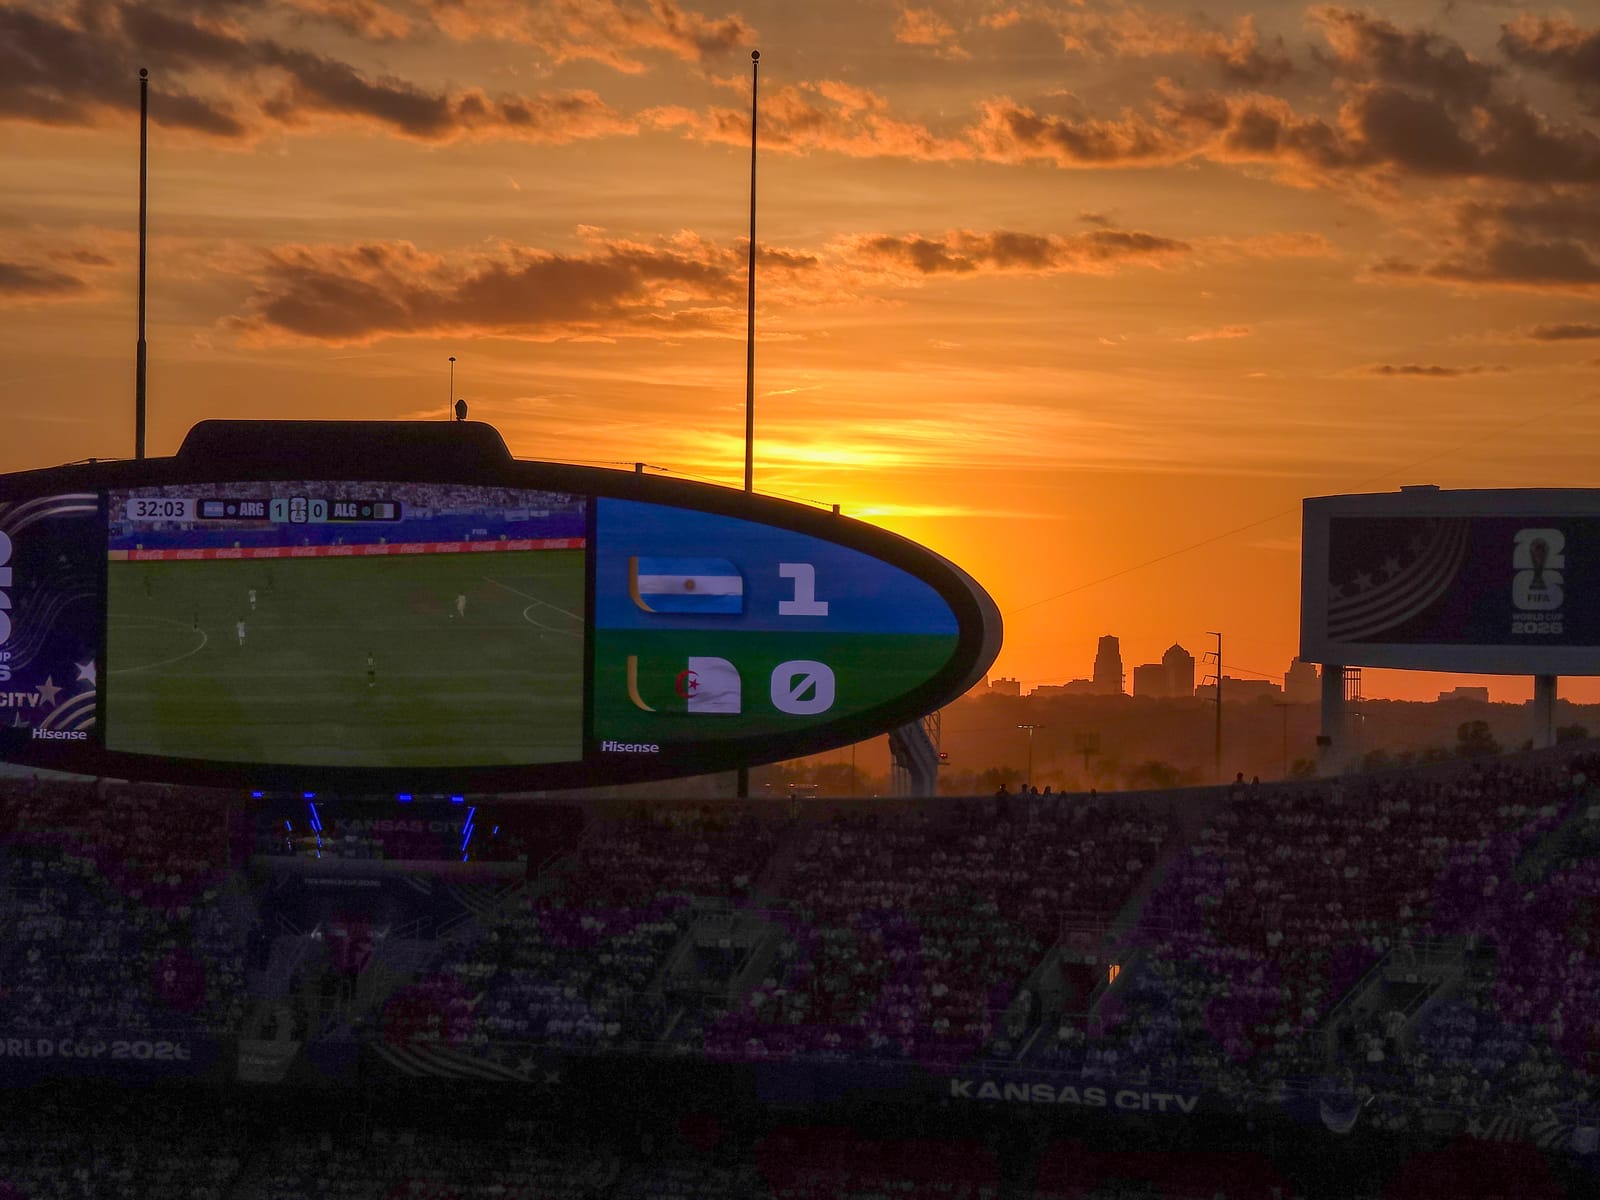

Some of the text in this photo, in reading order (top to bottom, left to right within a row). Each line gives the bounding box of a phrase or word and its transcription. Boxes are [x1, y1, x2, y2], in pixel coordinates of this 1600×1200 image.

[136, 501, 184, 517] 32:03
[239, 502, 265, 517] ARG
[274, 503, 283, 518] 1
[313, 503, 323, 518] 0
[333, 503, 358, 518] ALG
[778, 562, 829, 617] 1
[1511, 621, 1564, 634] 2026
[770, 659, 836, 716] 0
[31, 727, 88, 740] Hisense
[601, 740, 661, 754] Hisense
[950, 1078, 1200, 1114] KANSAS CITY
